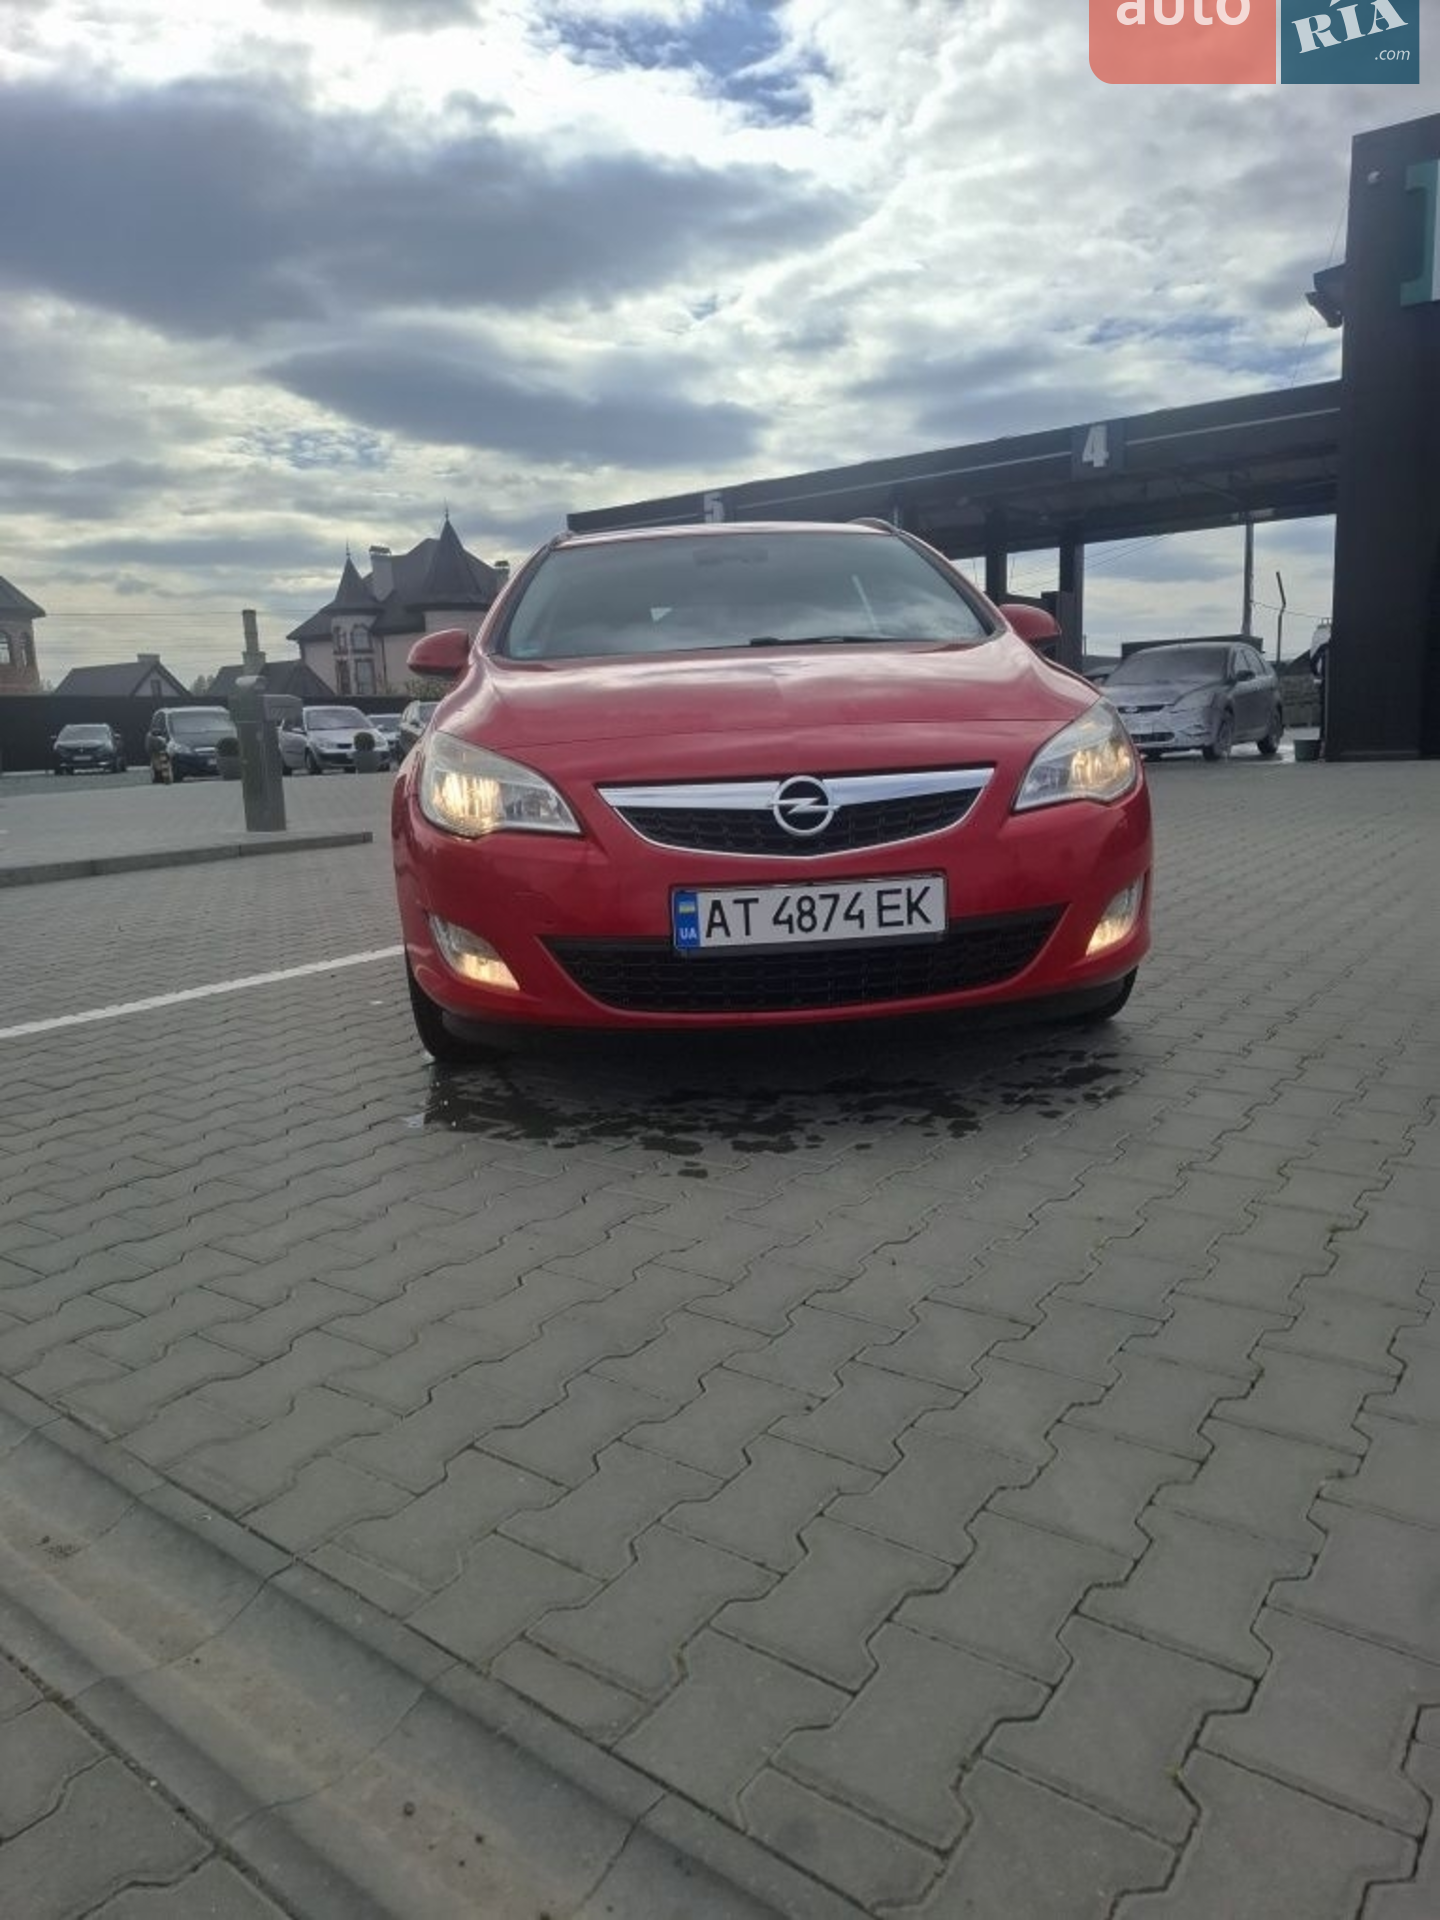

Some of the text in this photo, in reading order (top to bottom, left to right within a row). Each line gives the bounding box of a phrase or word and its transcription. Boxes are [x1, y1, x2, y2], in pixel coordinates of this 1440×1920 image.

[1082, 425, 1109, 467] 4
[703, 492, 725, 524] 5
[705, 886, 932, 938] AT 4874 EK
[679, 927, 698, 940] UA
